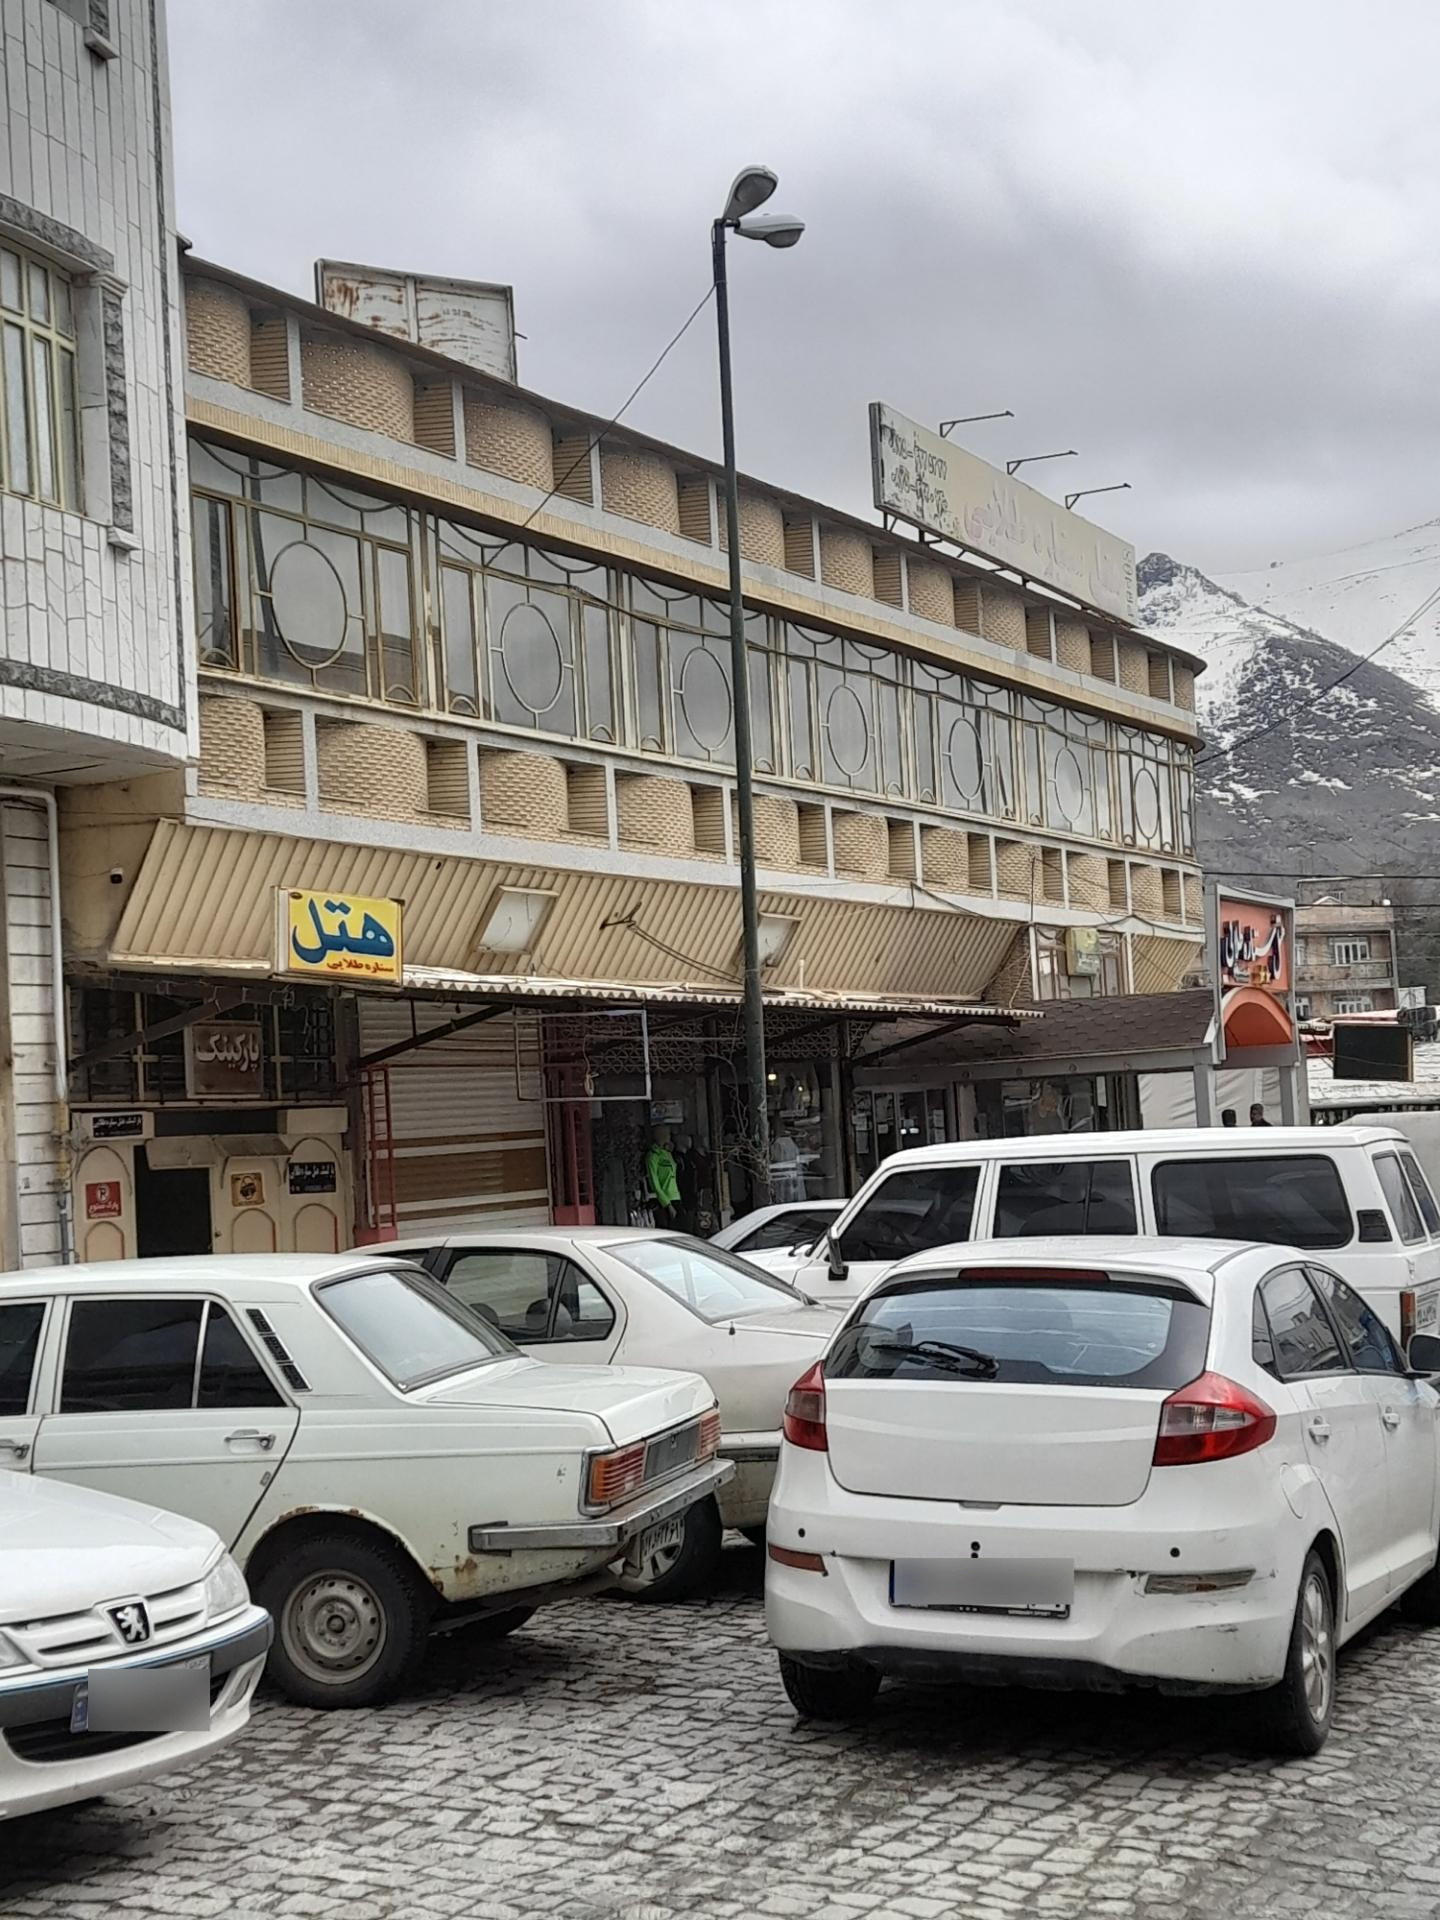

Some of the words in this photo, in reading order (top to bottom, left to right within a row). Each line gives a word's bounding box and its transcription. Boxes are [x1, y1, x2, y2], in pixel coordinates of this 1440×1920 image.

[291, 898, 394, 964] هتل
[327, 958, 363, 970] طلایی
[365, 962, 394, 973] ستاره
